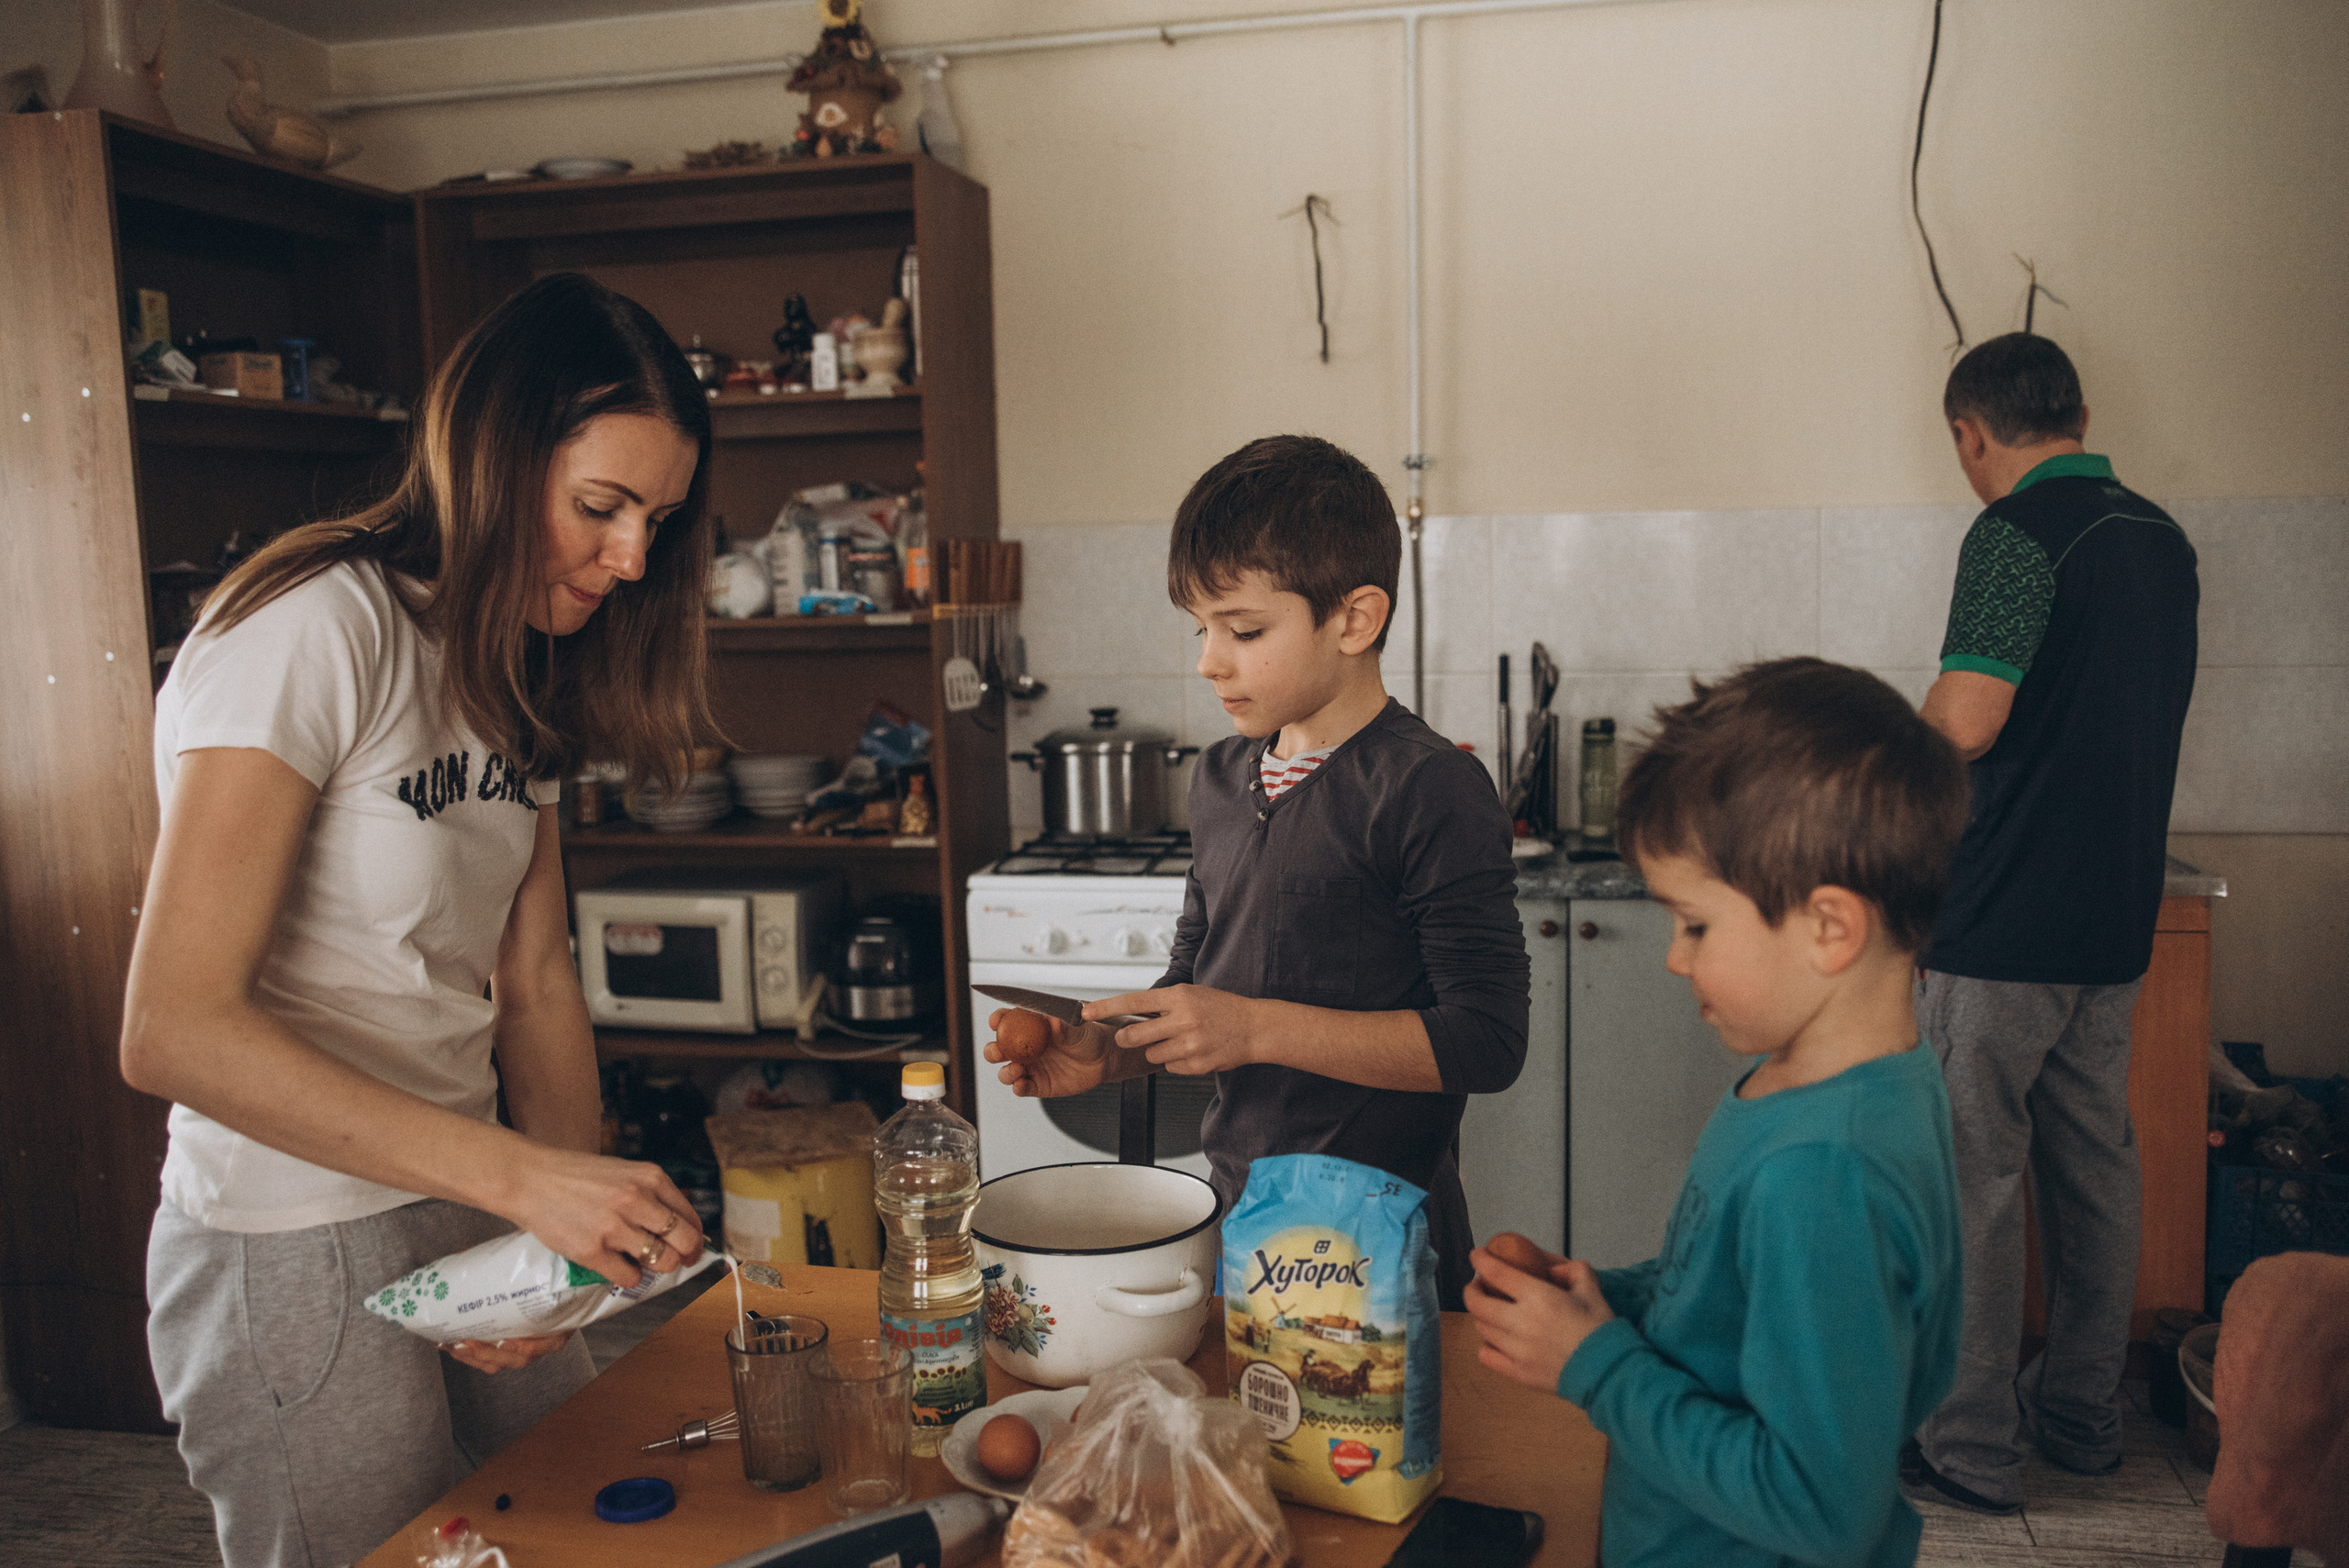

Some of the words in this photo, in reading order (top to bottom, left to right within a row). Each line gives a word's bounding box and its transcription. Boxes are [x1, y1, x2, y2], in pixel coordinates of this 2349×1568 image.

[1247, 1250, 1371, 1295] Хуторок
[457, 1299, 484, 1315] КЕФІР
[485, 1293, 508, 1307] 2,5%
[1248, 1373, 1288, 1403] БОРОШНО
[1248, 1393, 1288, 1422] ПШЕНИЧНЕ
